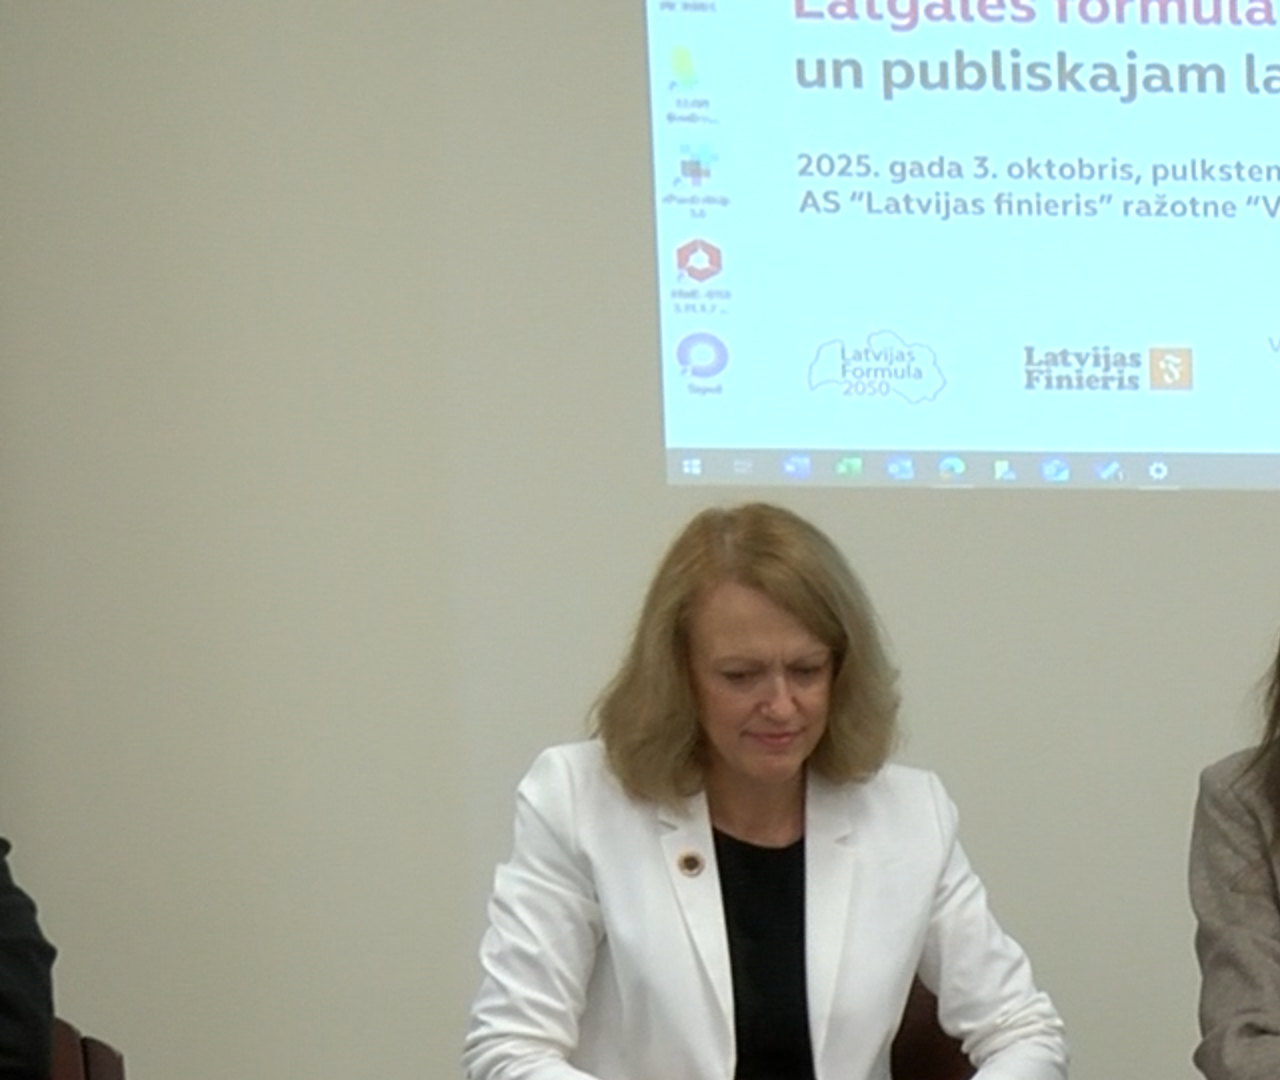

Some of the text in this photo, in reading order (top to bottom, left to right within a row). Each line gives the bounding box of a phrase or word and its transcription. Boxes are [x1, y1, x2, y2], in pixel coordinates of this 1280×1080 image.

[795, 57, 864, 89] un
[881, 47, 1226, 105] publiskajam
[797, 152, 880, 178] 2025.
[888, 155, 965, 185] gada
[973, 155, 998, 180] 3.
[1006, 156, 1142, 186] oktobris,
[799, 189, 842, 214] AS
[1122, 193, 1237, 219] ražotne
[841, 346, 916, 364] Latvijas
[1023, 345, 1143, 374] Latvijas
[841, 364, 923, 381] Formula
[1024, 369, 1140, 391] Finieris
[843, 381, 890, 397] 2050
